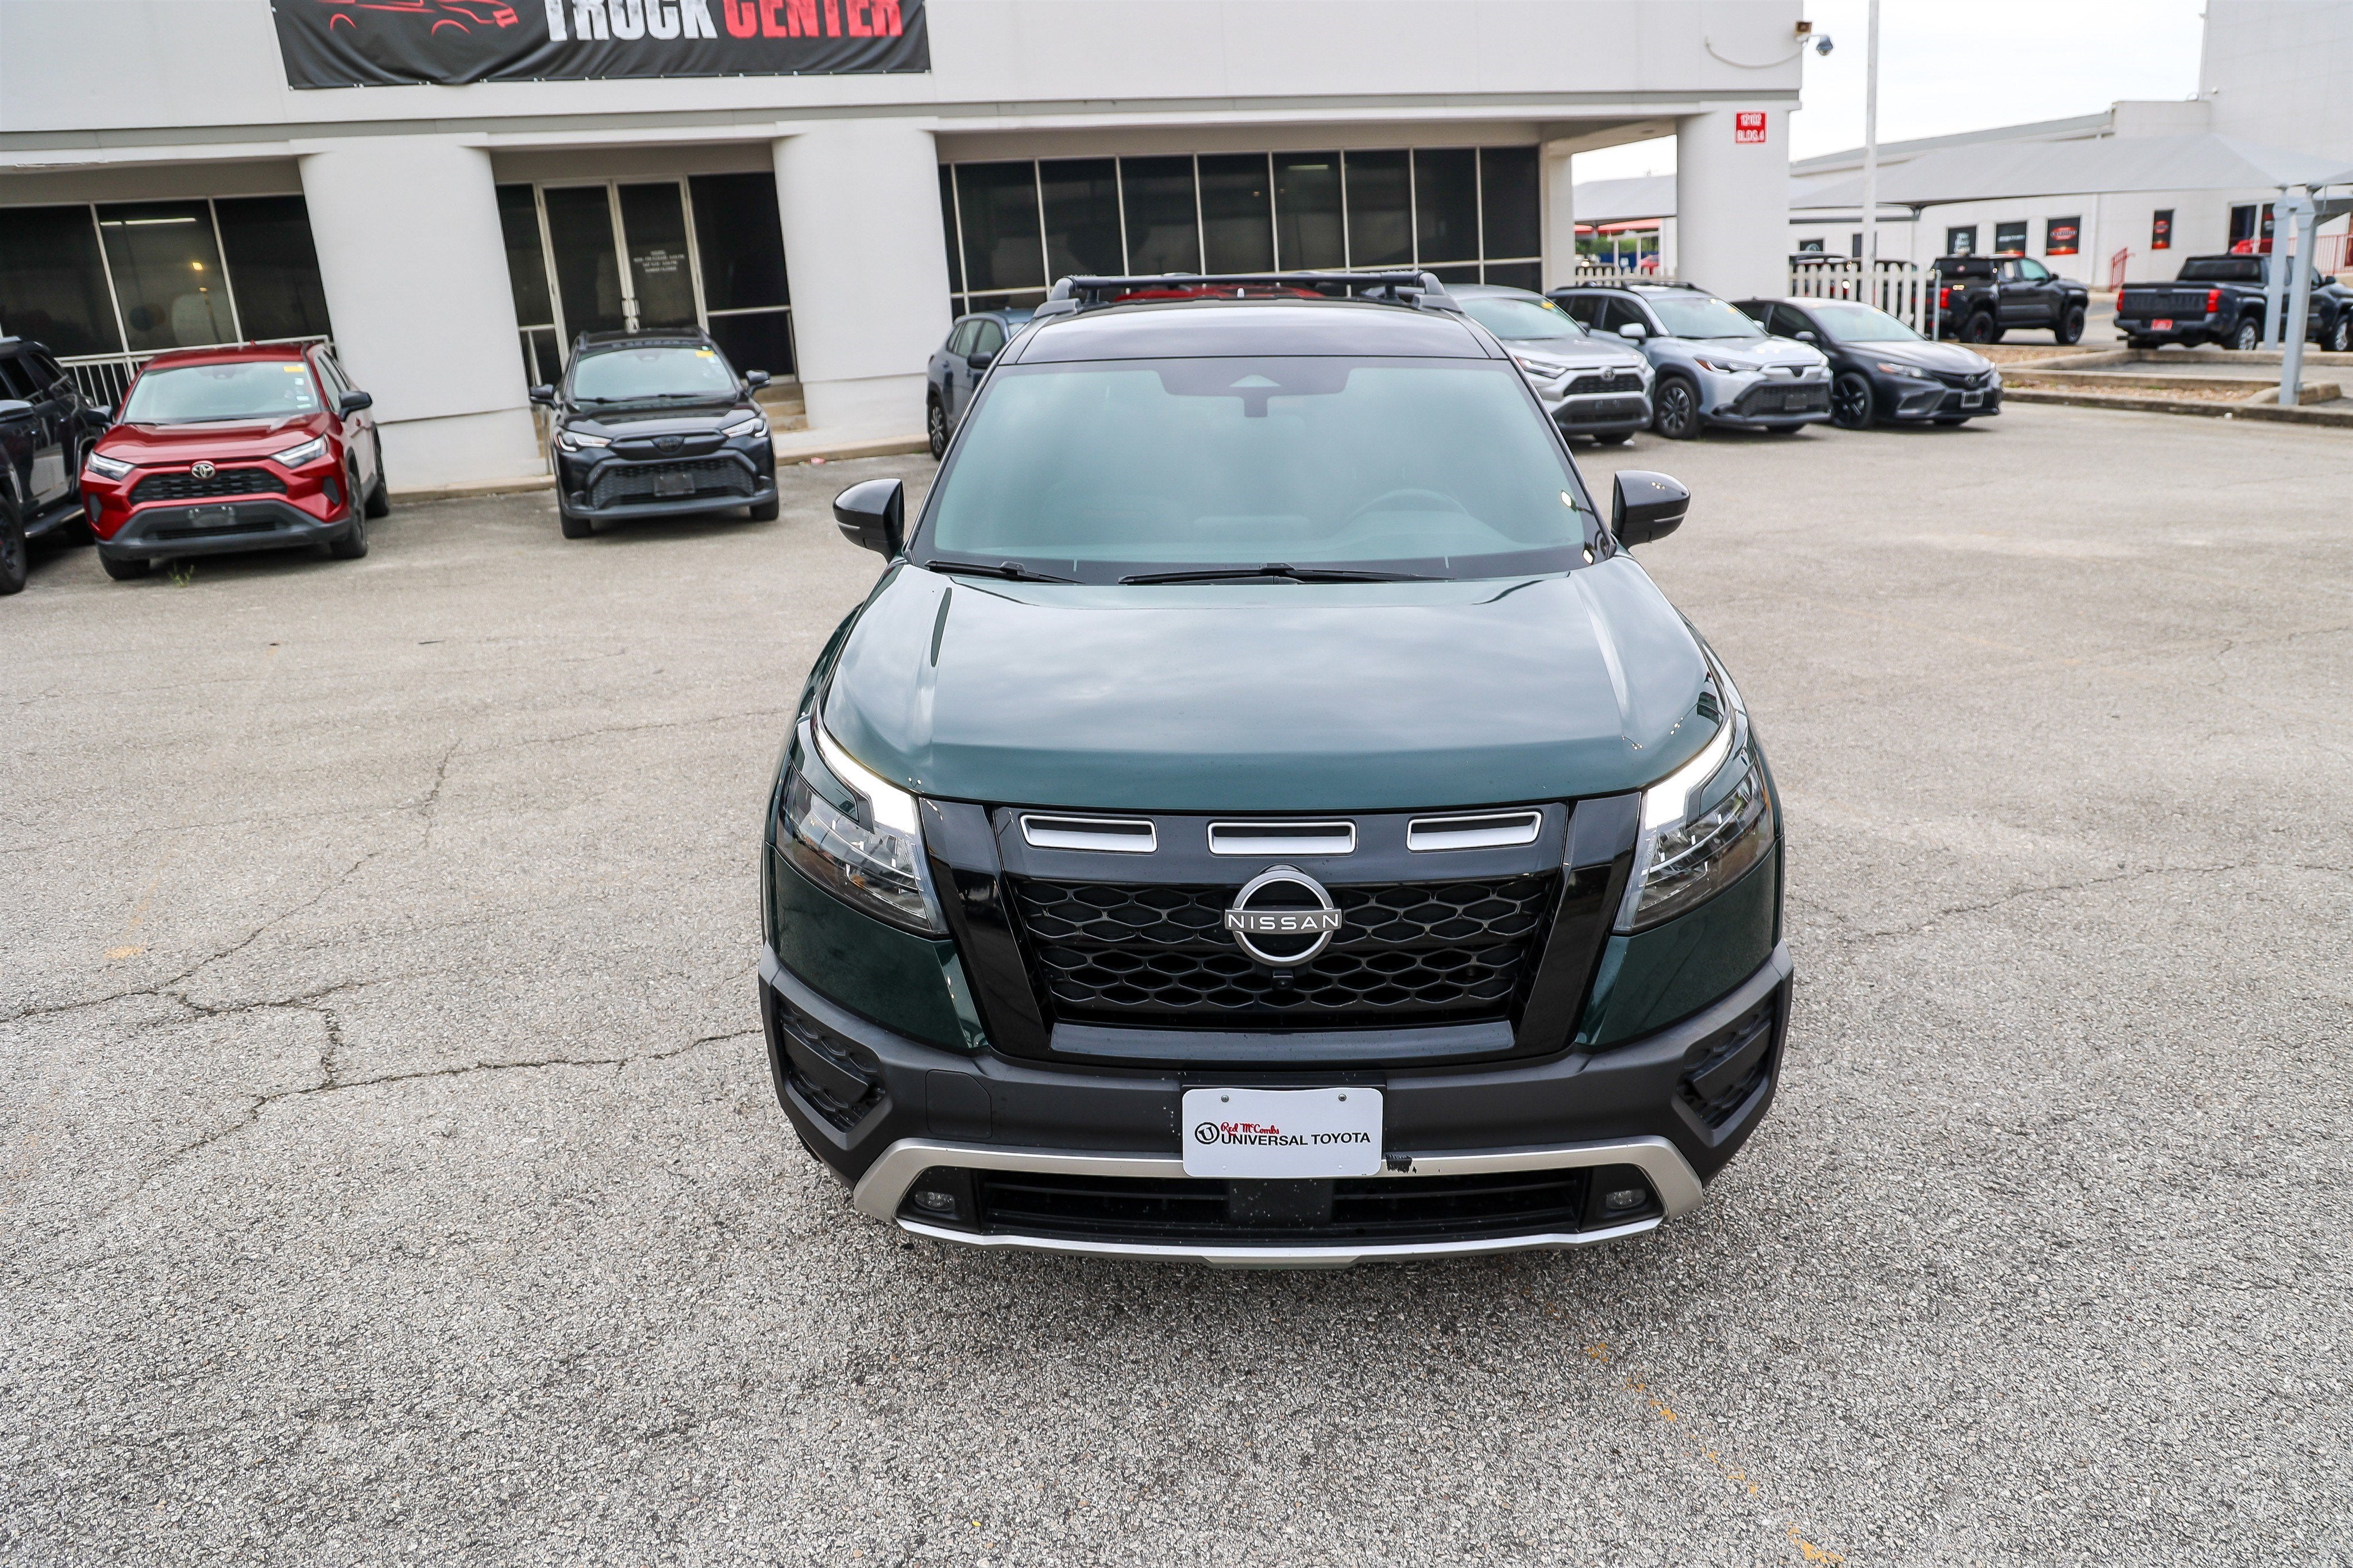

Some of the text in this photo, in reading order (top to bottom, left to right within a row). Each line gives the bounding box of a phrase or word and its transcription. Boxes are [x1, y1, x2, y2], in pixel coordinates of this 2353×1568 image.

[545, 0, 903, 41] TRUCK CENTER
[1228, 913, 1338, 930] NISSAN
[1221, 1122, 1239, 1136] Red
[1221, 1132, 1371, 1146] UNIVERSAL TOYOTA
